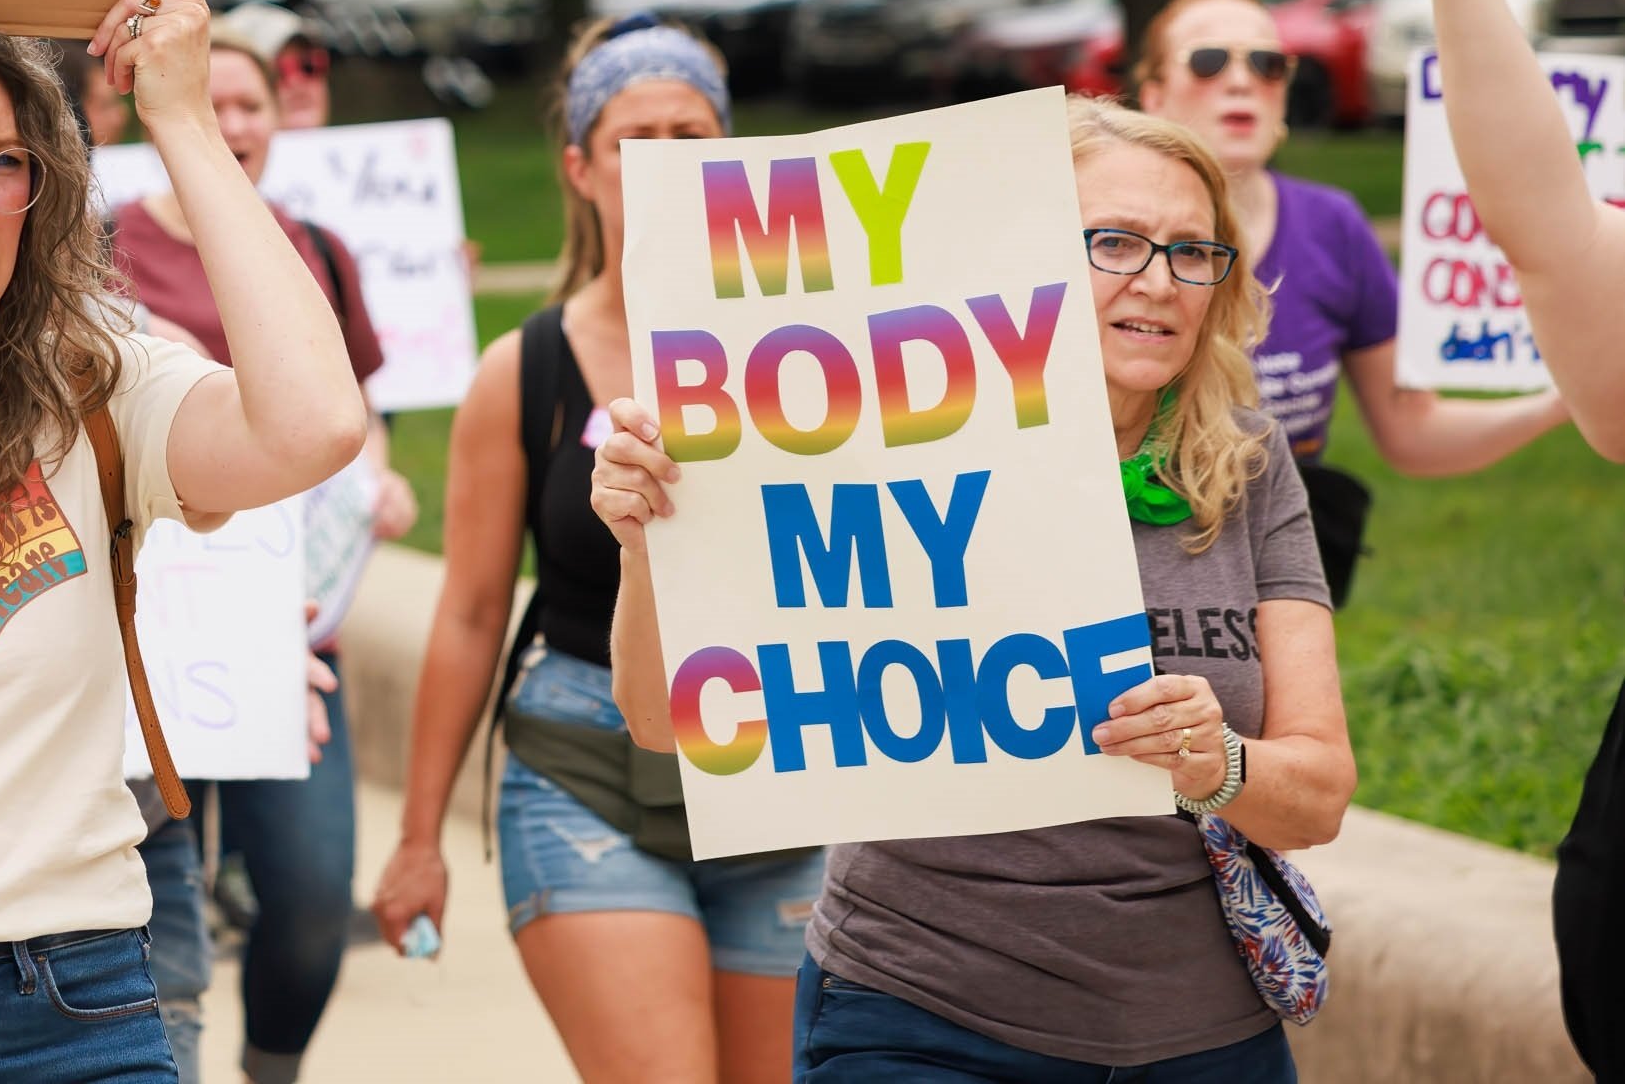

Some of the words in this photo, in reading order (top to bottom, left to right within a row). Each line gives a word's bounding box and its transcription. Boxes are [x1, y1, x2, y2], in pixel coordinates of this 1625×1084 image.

[702, 142, 931, 298] MY
[651, 282, 1067, 463] BODY
[761, 470, 991, 608] MY
[670, 612, 1152, 776] CHOICE
